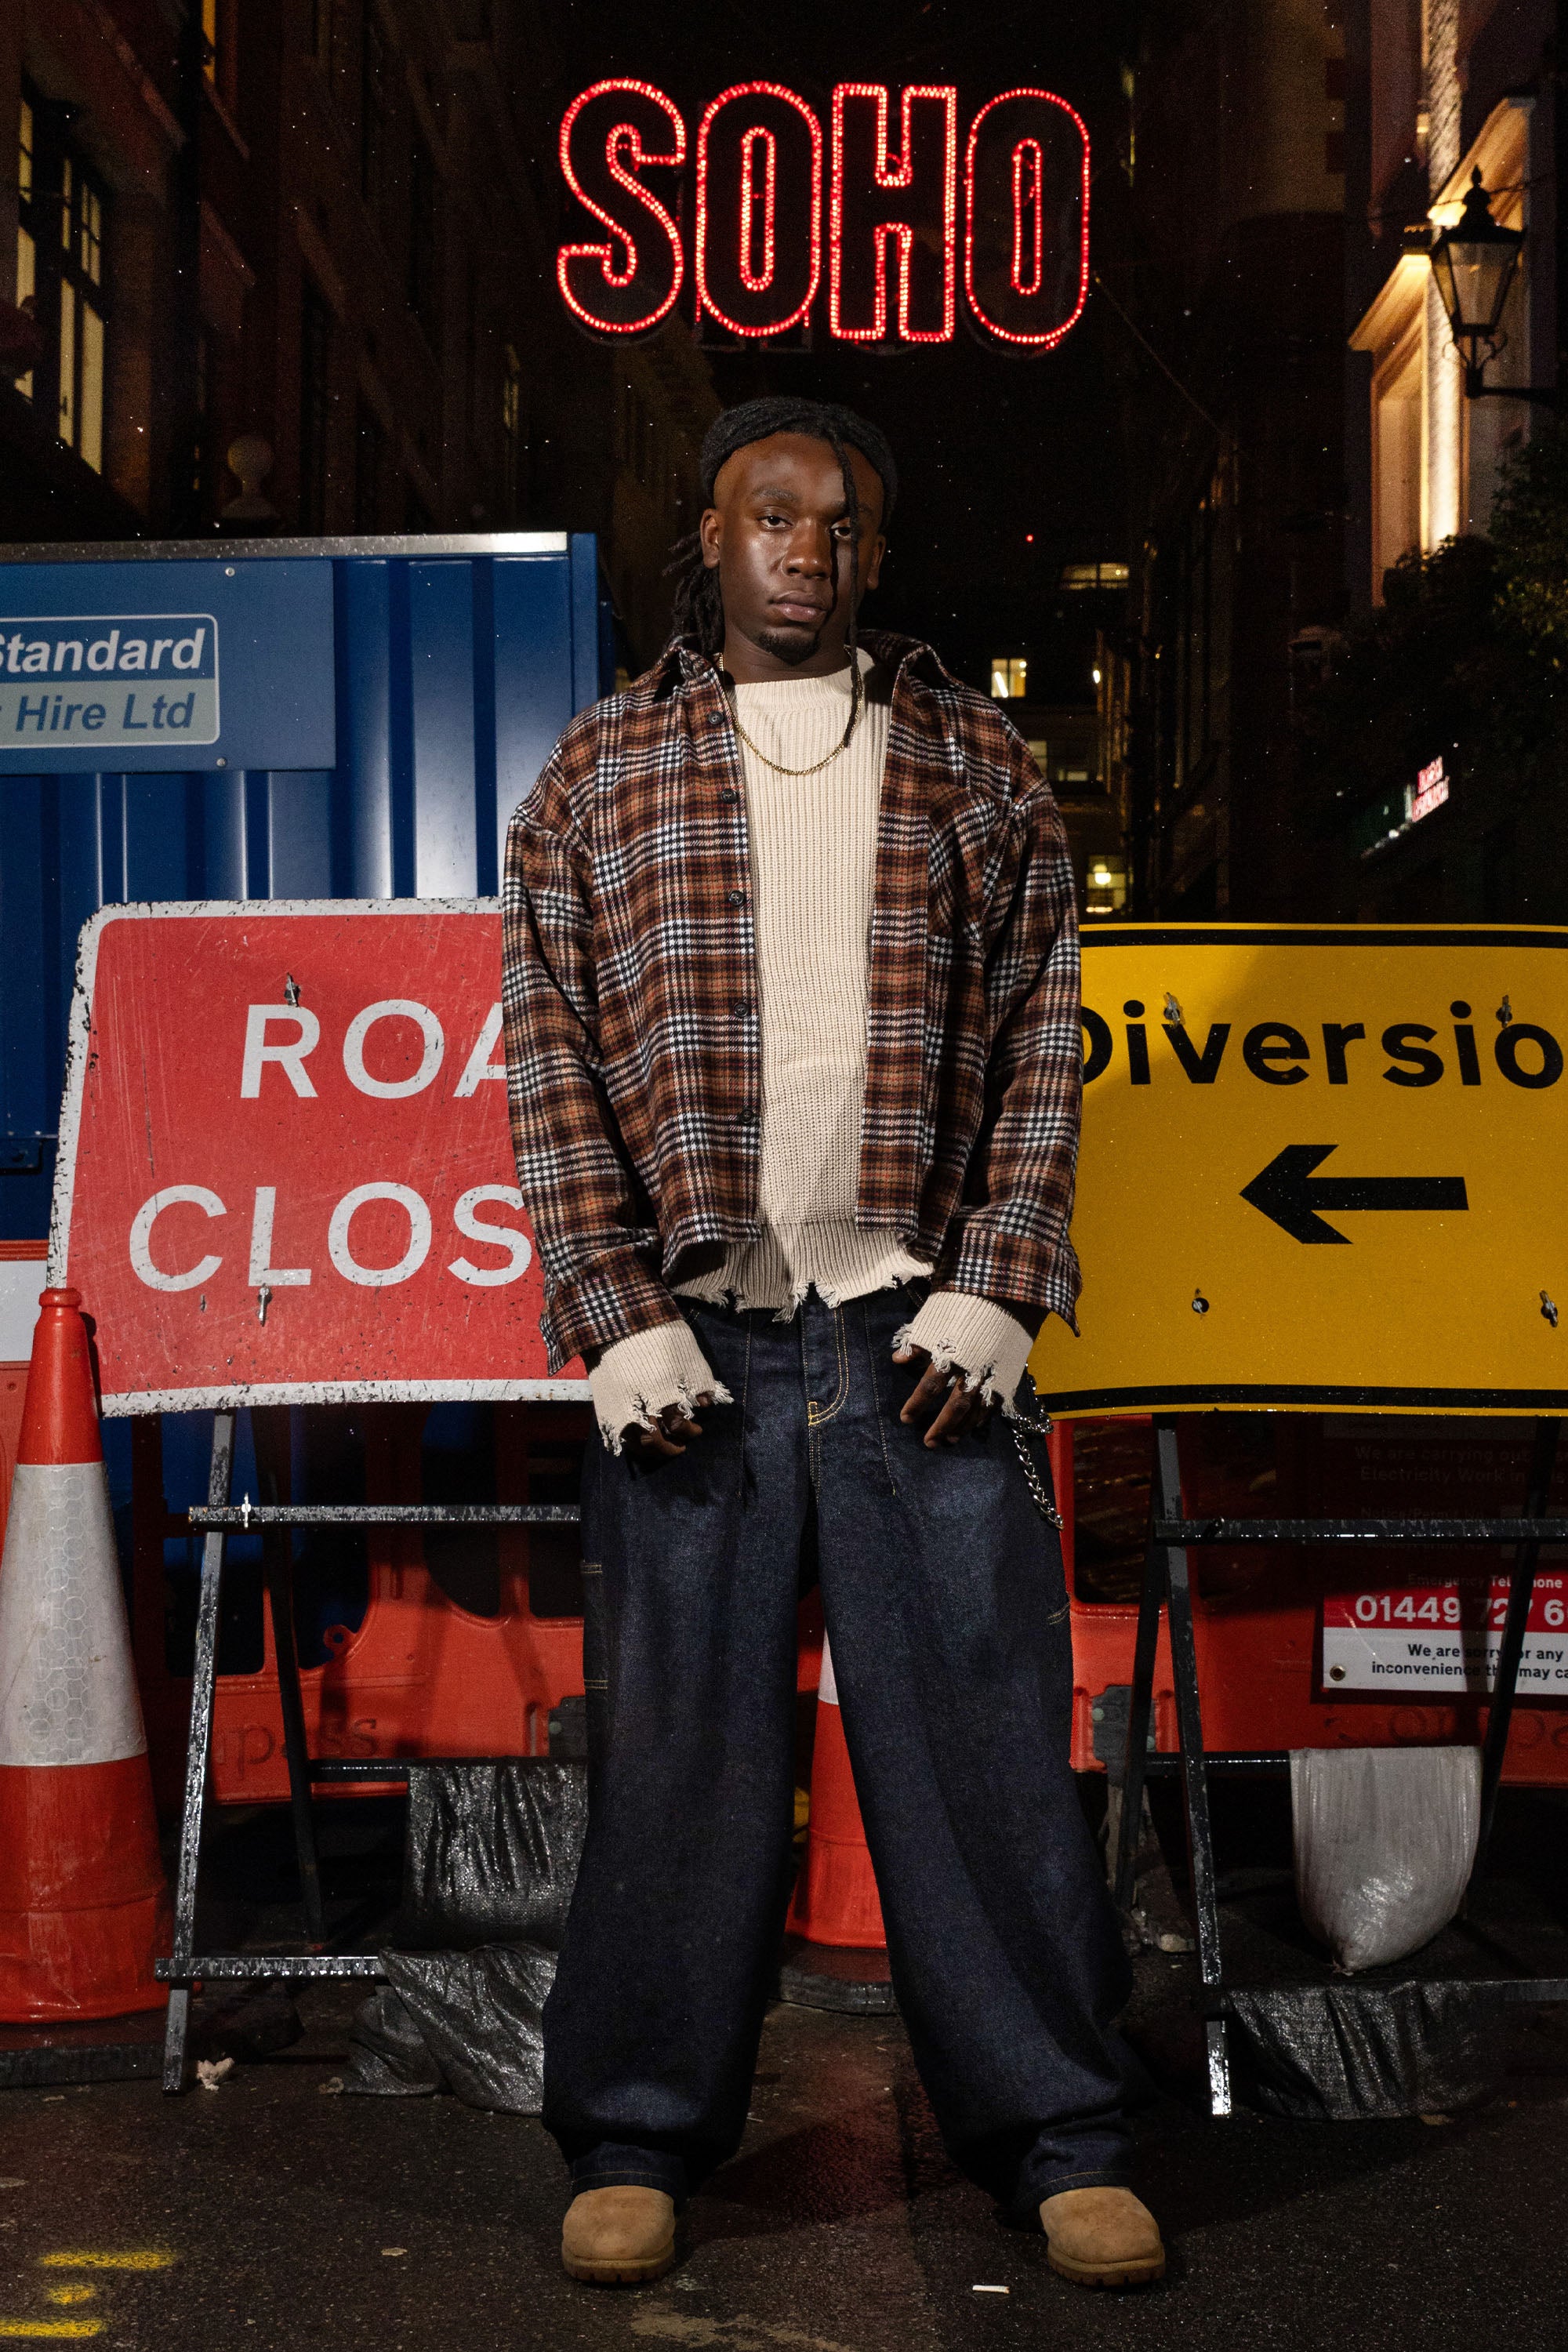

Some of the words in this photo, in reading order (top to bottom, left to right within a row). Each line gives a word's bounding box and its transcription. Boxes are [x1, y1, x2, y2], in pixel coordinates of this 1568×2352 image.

[557, 78, 1091, 345] SOHO
[0, 628, 205, 673] tandard
[16, 695, 106, 732] Hire
[122, 692, 195, 731] Ltd
[129, 1181, 533, 1293] CLOS
[1355, 1445, 1381, 1460] We
[1387, 1449, 1416, 1461] are
[1421, 1446, 1494, 1465] carrying
[1500, 1447, 1532, 1463] out
[1360, 1465, 1450, 1484] Electricity
[1457, 1468, 1506, 1483] Work
[1408, 1572, 1485, 1589] Emergency
[1490, 1574, 1563, 1588] Telone
[1356, 1595, 1461, 1624] 01449
[1473, 1597, 1534, 1624] 72
[1408, 1643, 1431, 1657] We
[1436, 1645, 1461, 1657] are
[1537, 1650, 1563, 1663] any
[1371, 1661, 1480, 1676] inconvenience
[1519, 1668, 1551, 1681] may
